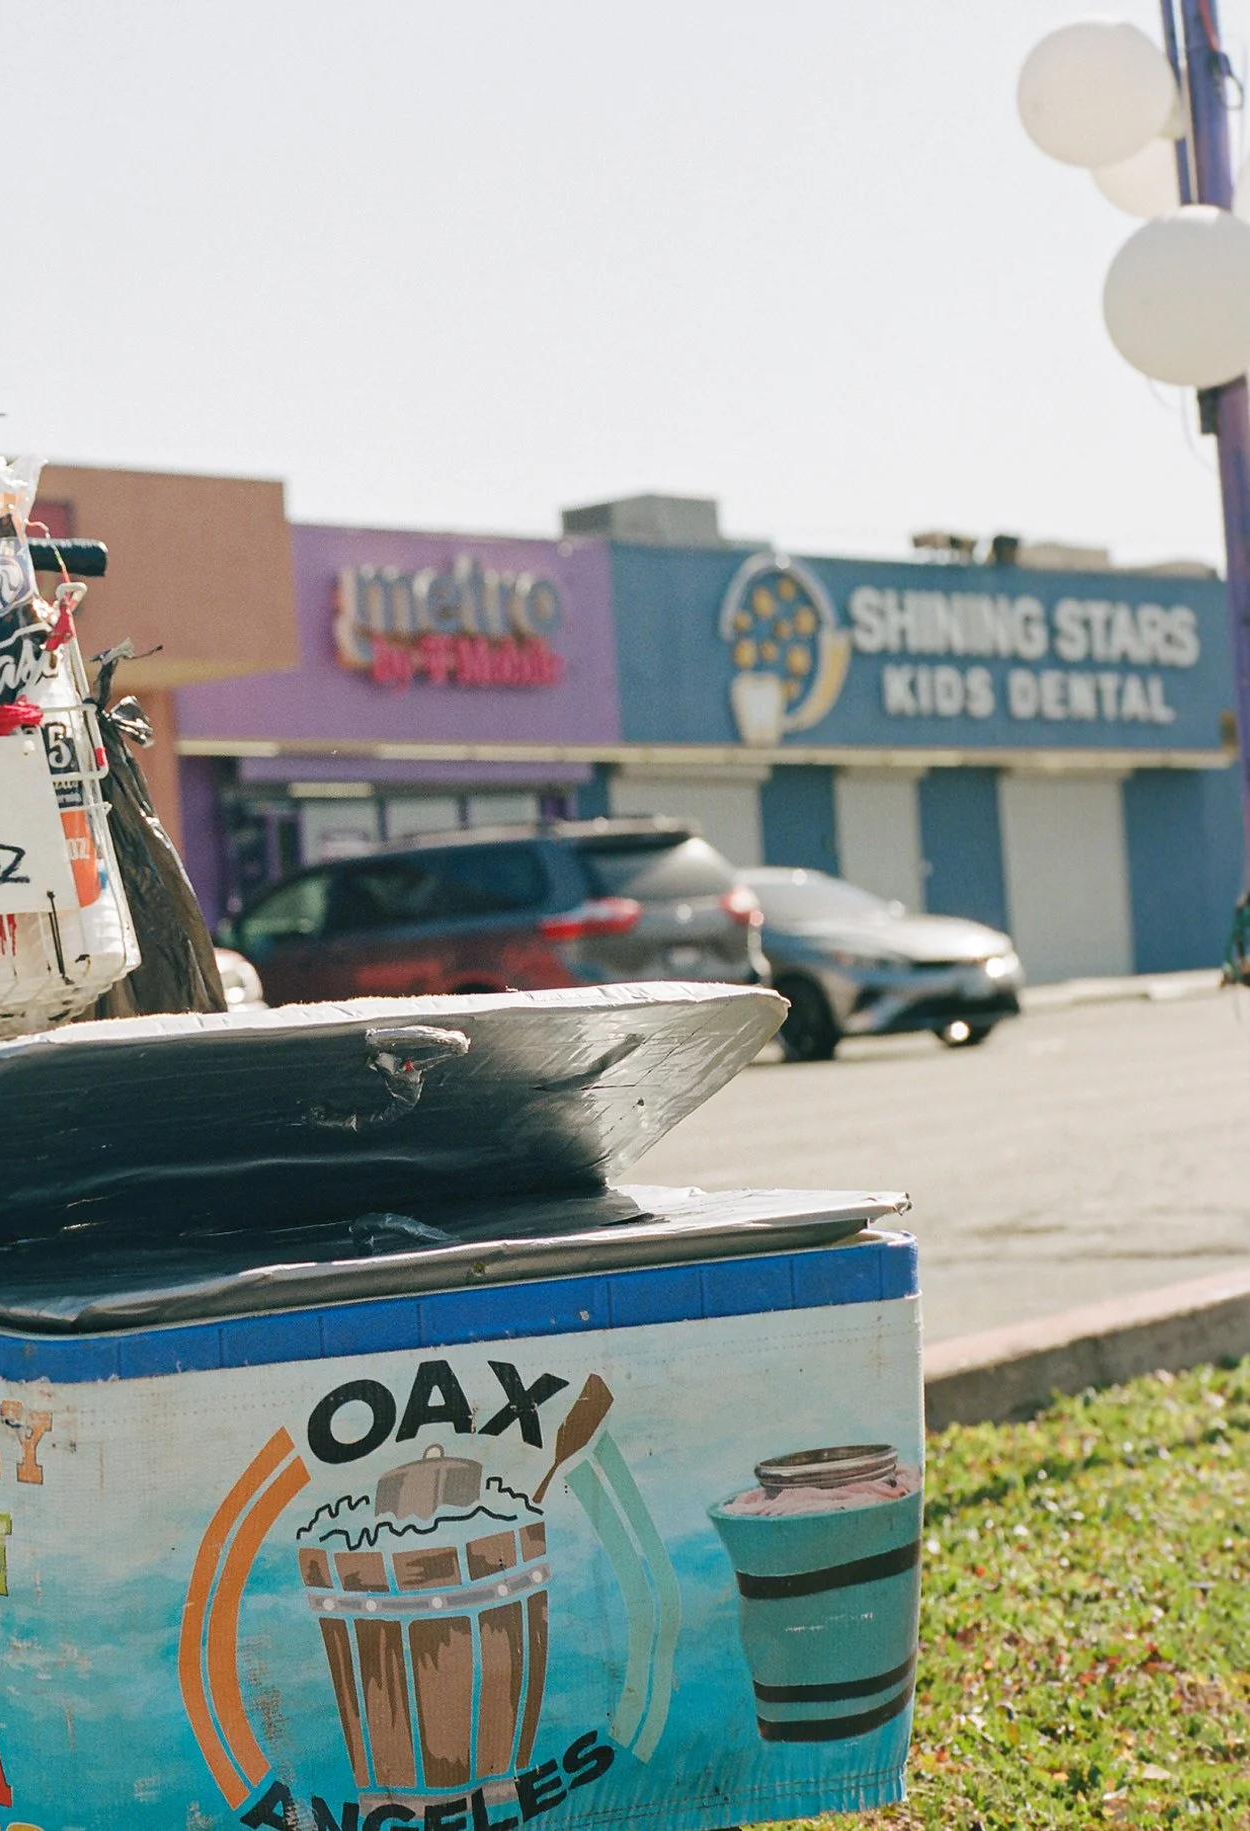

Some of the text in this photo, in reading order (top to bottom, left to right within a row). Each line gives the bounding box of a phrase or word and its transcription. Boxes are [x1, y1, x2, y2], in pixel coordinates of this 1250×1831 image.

[334, 553, 564, 669] metro
[850, 585, 1200, 668] SHINING STARS
[882, 664, 1177, 723] KIDS DENTAL
[307, 1359, 570, 1464] OAX
